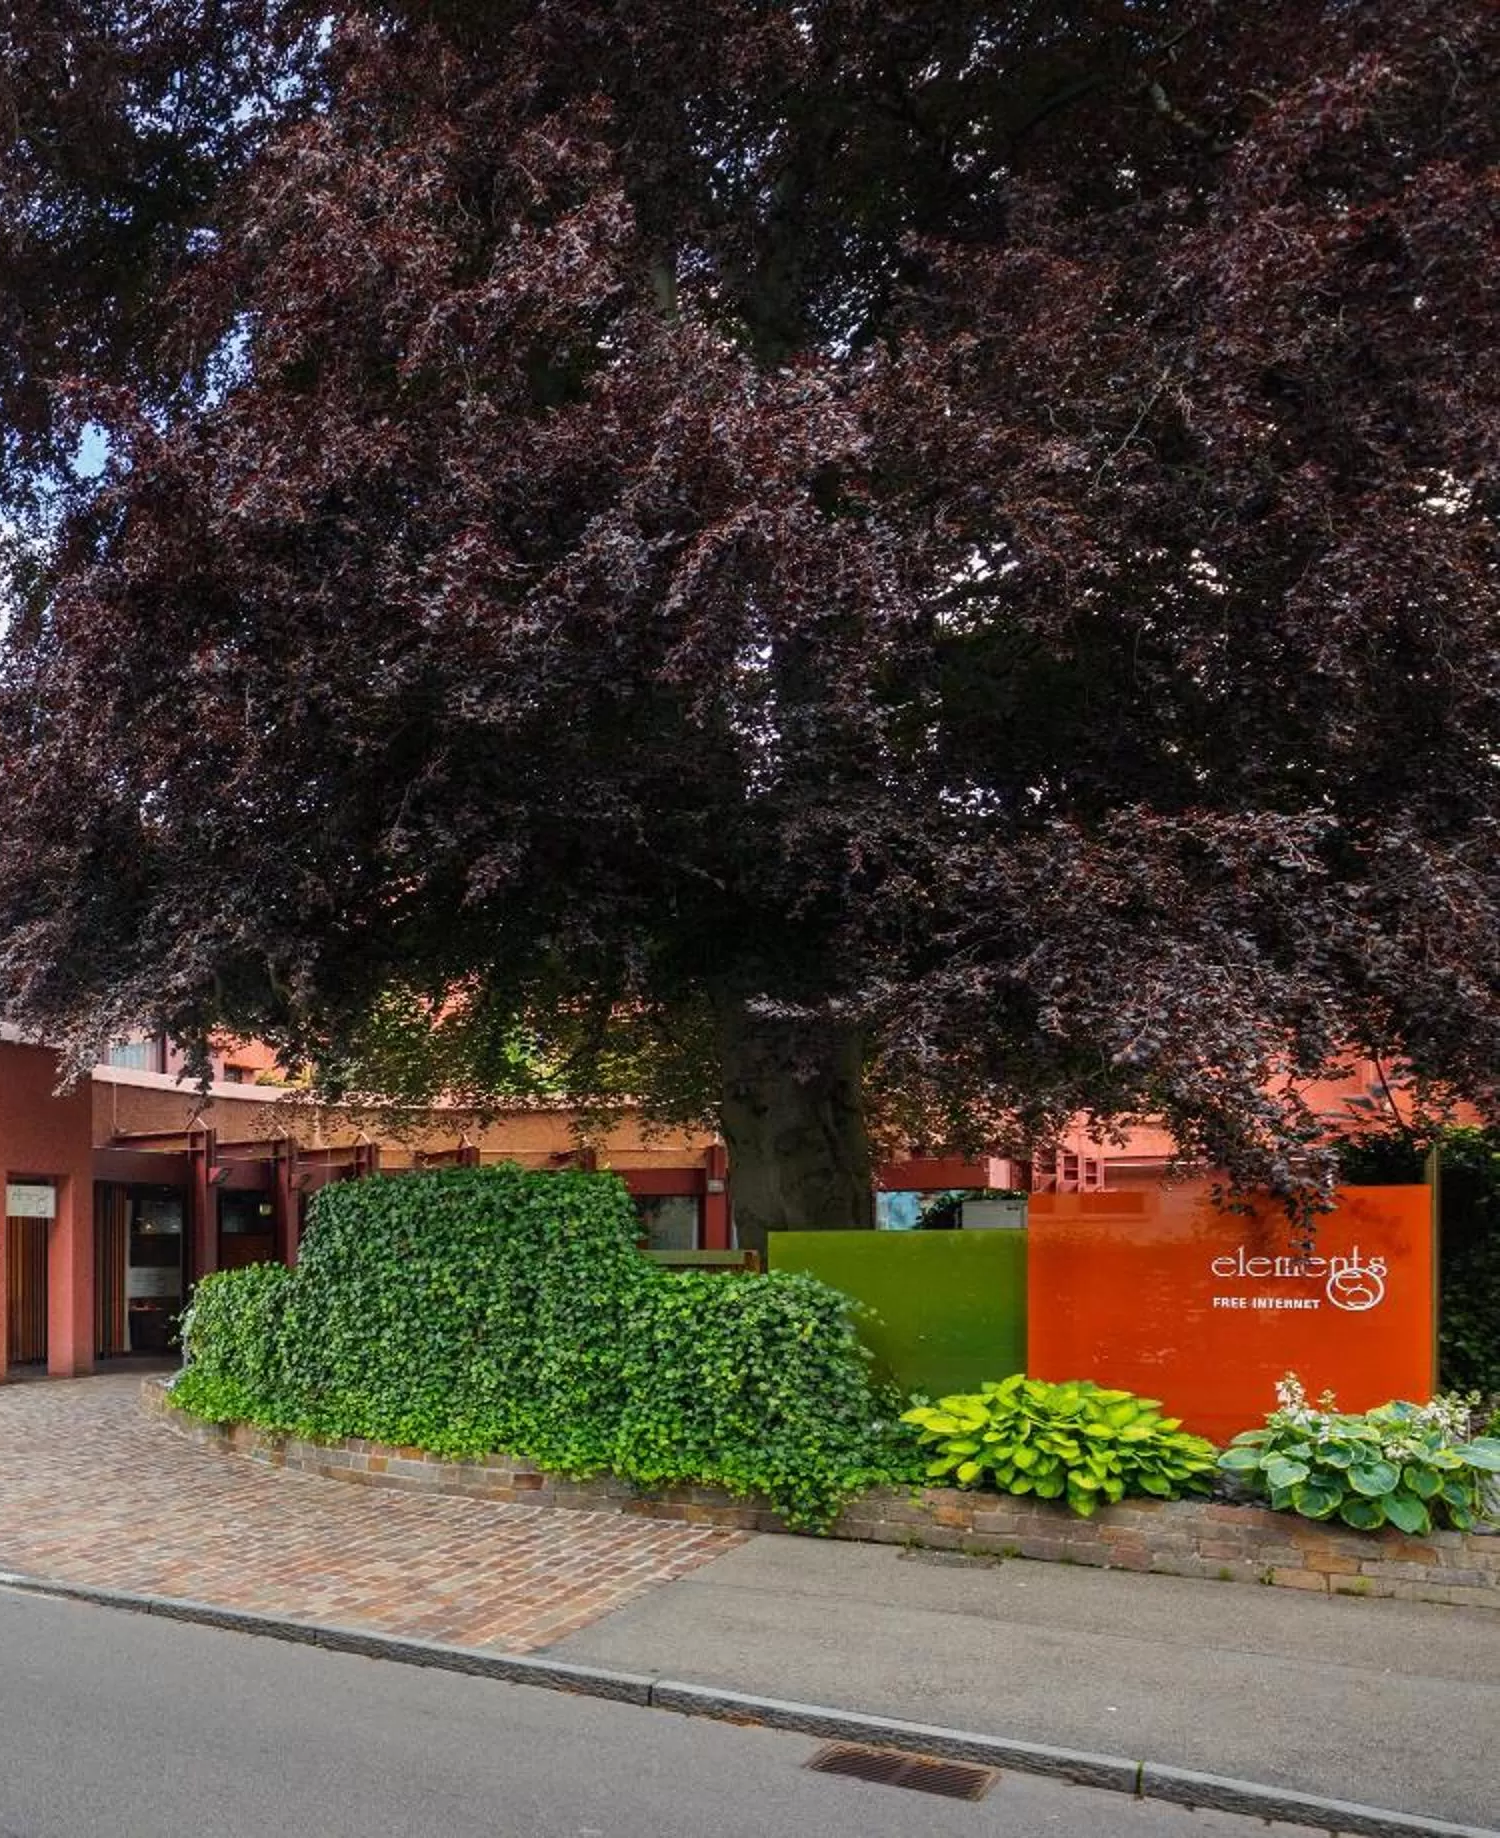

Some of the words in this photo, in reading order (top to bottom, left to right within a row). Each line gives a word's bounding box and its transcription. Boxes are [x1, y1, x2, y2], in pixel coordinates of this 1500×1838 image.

[1211, 1245, 1387, 1278] elements
[1212, 1296, 1248, 1309] FREE
[1252, 1297, 1321, 1310] INTERNET
